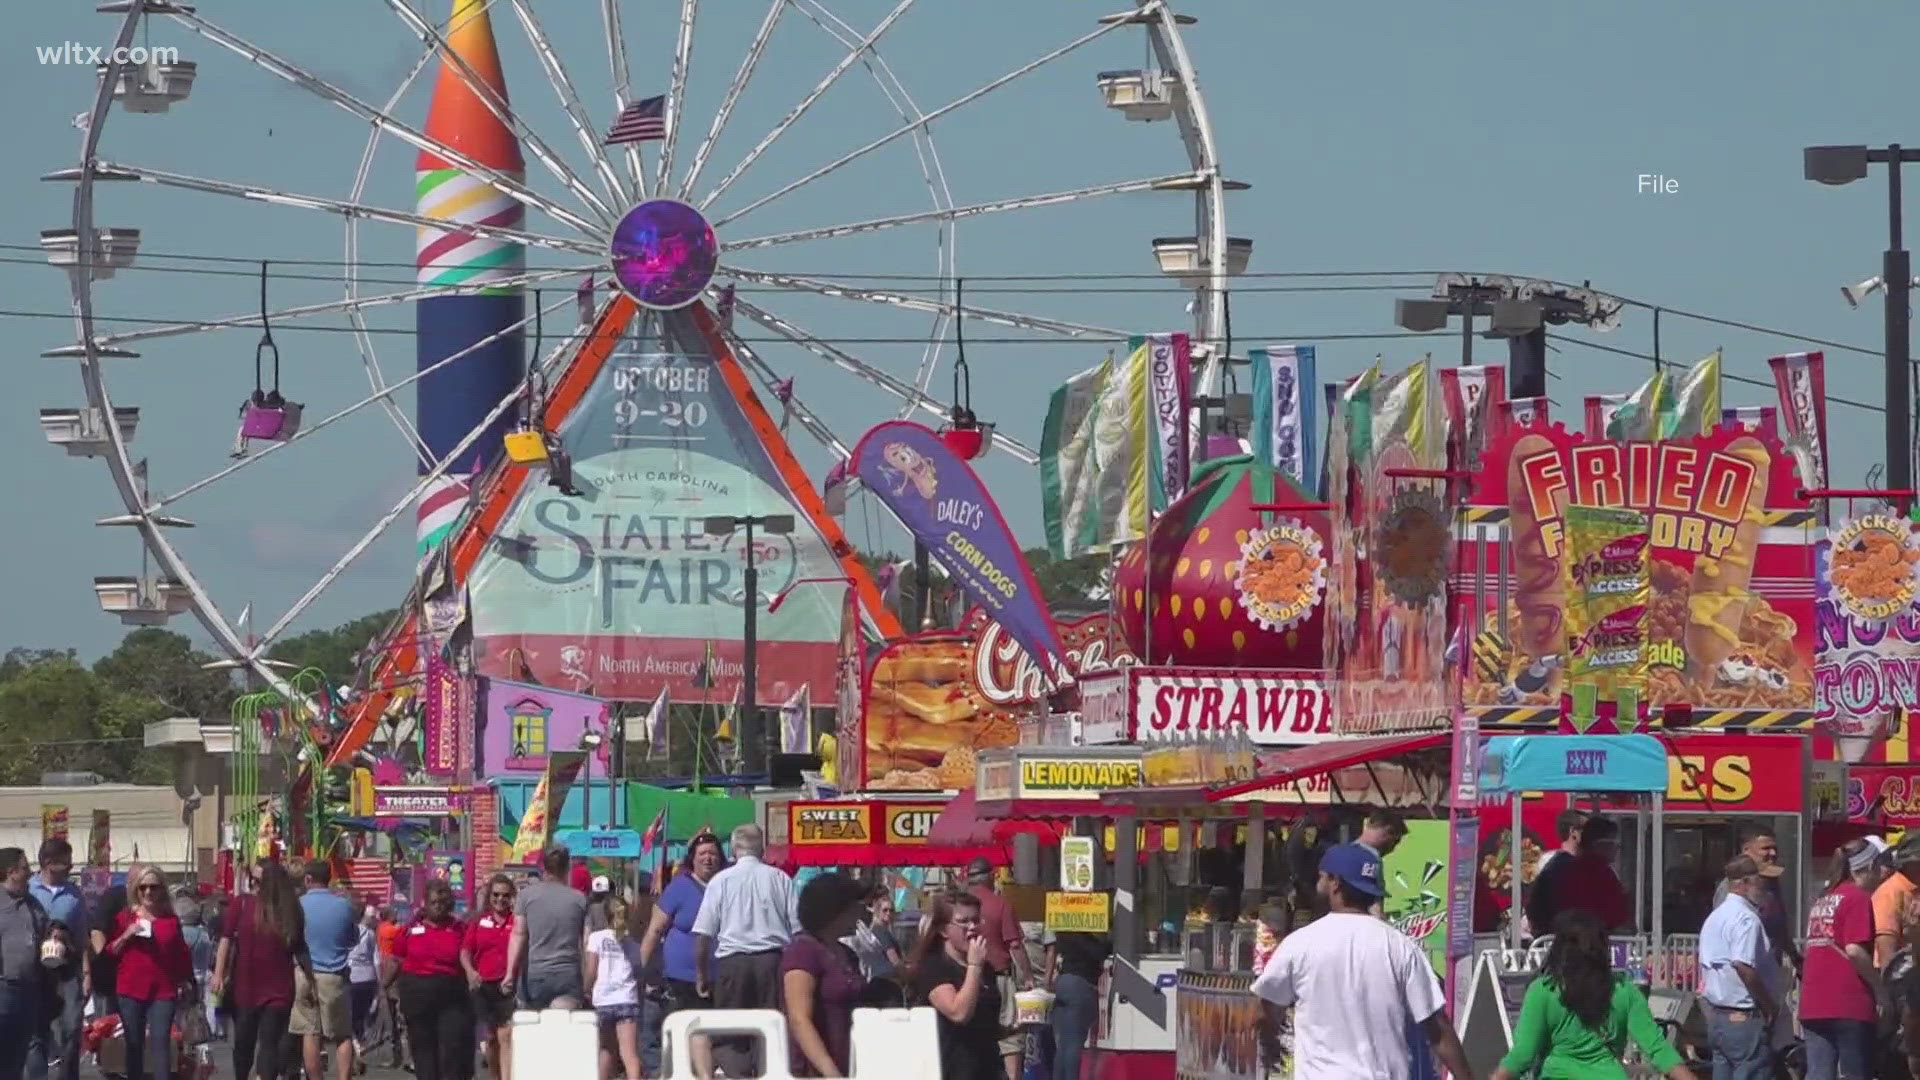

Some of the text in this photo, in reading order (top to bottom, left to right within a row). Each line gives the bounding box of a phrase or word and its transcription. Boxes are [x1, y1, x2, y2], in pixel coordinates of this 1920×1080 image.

[613, 366, 711, 393] OCTOBER
[614, 400, 708, 428] 9-20
[1167, 435, 1180, 497] CAND
[593, 471, 729, 496] OUTH CAROLINA
[1521, 443, 1757, 523] FRIED
[937, 498, 984, 531] DALEY'S
[521, 498, 711, 584] STATE
[1540, 512, 1737, 559] FORY
[946, 531, 985, 568] CORN
[980, 560, 1018, 598] DOGS
[599, 556, 738, 629] FAIR
[1588, 578, 1642, 594] ACCESS
[599, 655, 640, 674] NORTH
[644, 656, 704, 676] AMERICA
[1588, 650, 1640, 667] ACCESS
[1022, 761, 1140, 789] LEMONADE
[1565, 750, 1607, 775] EXIT
[384, 796, 448, 807] THEATER
[801, 809, 861, 821] SWEET
[798, 820, 867, 840] TEA
